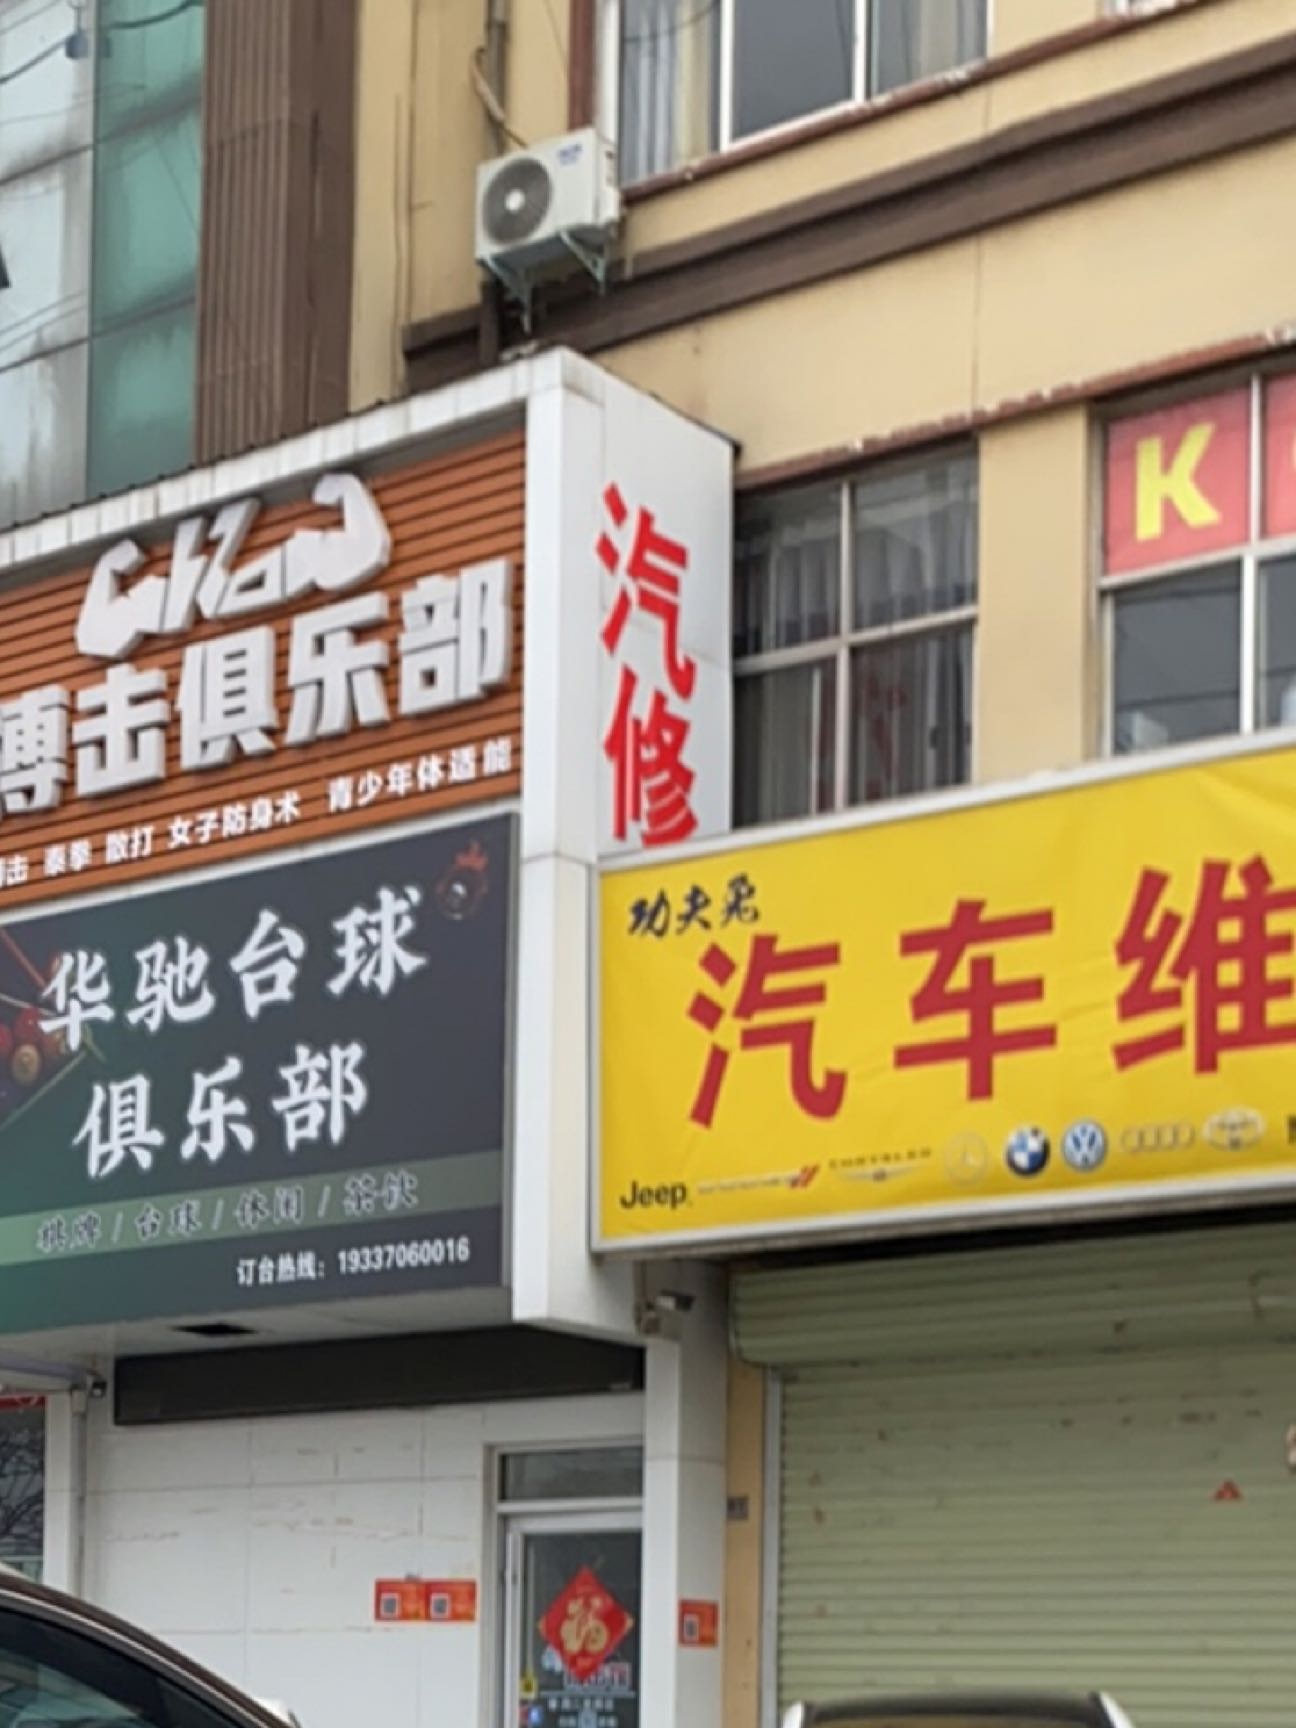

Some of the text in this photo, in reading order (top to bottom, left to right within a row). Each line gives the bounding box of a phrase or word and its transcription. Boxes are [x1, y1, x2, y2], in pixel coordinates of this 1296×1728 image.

[1136, 423, 1219, 541] K
[596, 477, 698, 848] 汽修
[105, 824, 155, 865] 散打
[167, 790, 301, 848] 女子防身术
[327, 737, 512, 813] 青少年体适能
[38, 885, 428, 1052] 华驰台球
[687, 853, 1296, 1130] 汽车维
[73, 1042, 369, 1178] 俱乐部
[337, 1235, 470, 1275] 19337060016
[620, 1180, 687, 1210] Jeep
